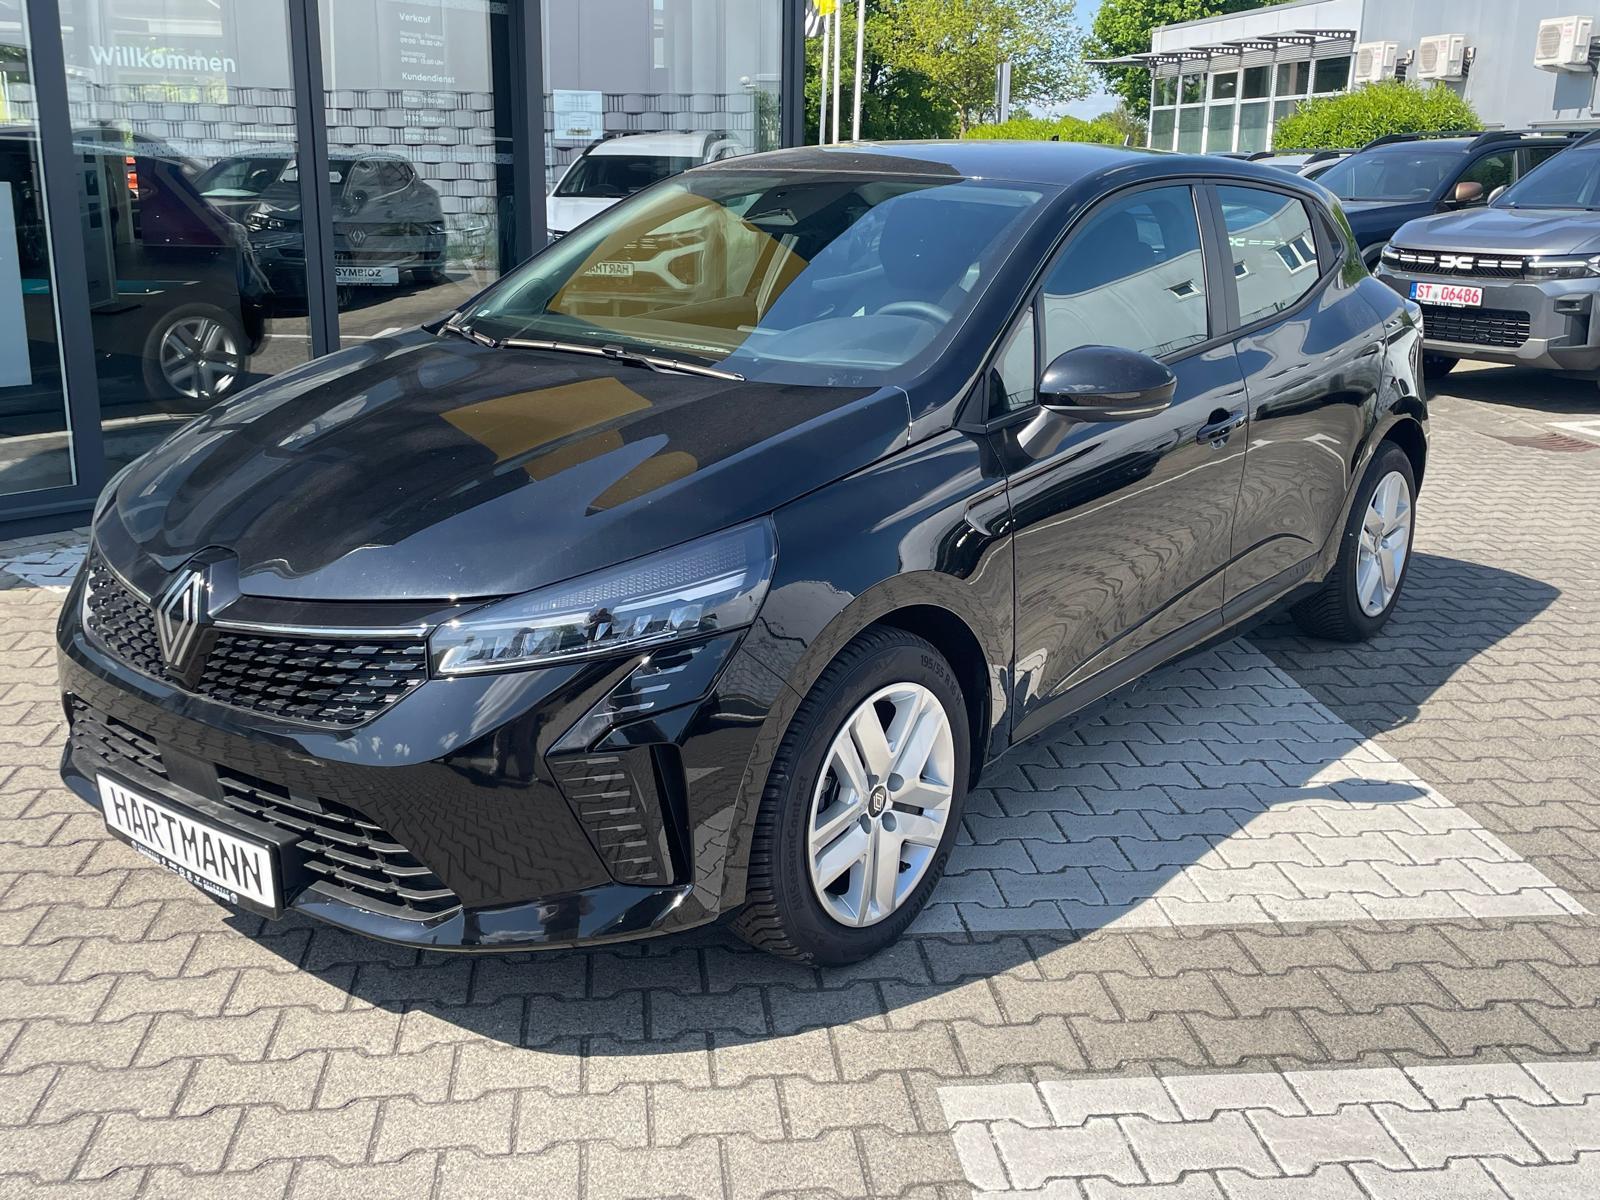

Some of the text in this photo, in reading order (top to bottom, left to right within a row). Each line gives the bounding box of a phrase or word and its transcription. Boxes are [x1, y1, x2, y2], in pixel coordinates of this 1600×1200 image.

[399, 12, 431, 23] Verkauf
[89, 45, 236, 73] Willkommen
[402, 72, 455, 84] Kundendienst
[335, 268, 381, 277] SYMBIOZ
[1417, 285, 1432, 298] ST
[1441, 287, 1479, 304] 06486
[921, 655, 945, 678] 195/55
[110, 787, 263, 895] HARTMANN
